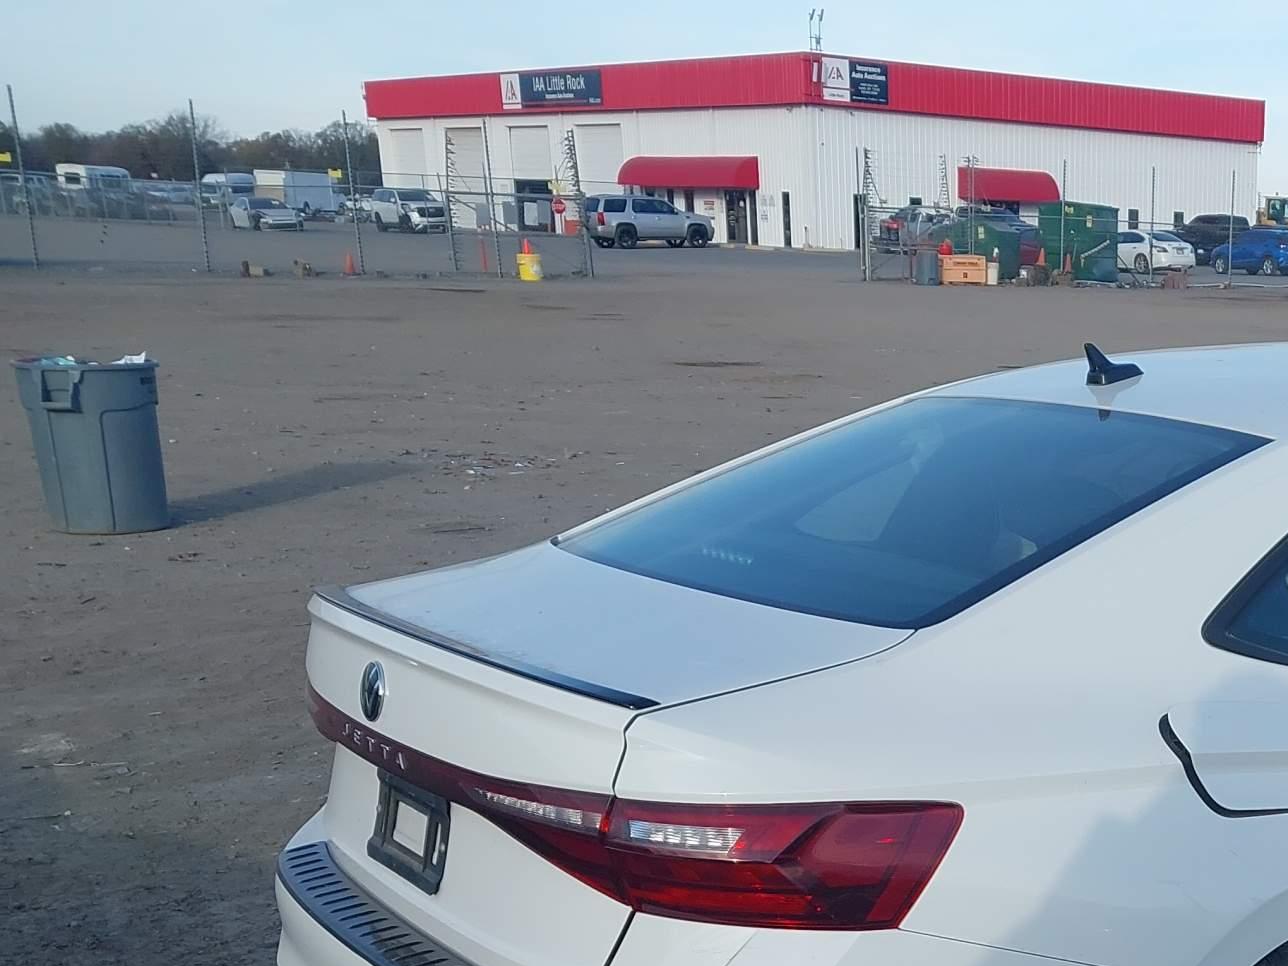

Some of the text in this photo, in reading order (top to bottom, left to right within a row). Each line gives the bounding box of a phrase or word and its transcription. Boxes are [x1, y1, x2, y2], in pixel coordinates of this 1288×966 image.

[532, 74, 586, 91] IAA Little Rock
[851, 71, 886, 81] Auto Auctions
[342, 723, 407, 770] JETTA
